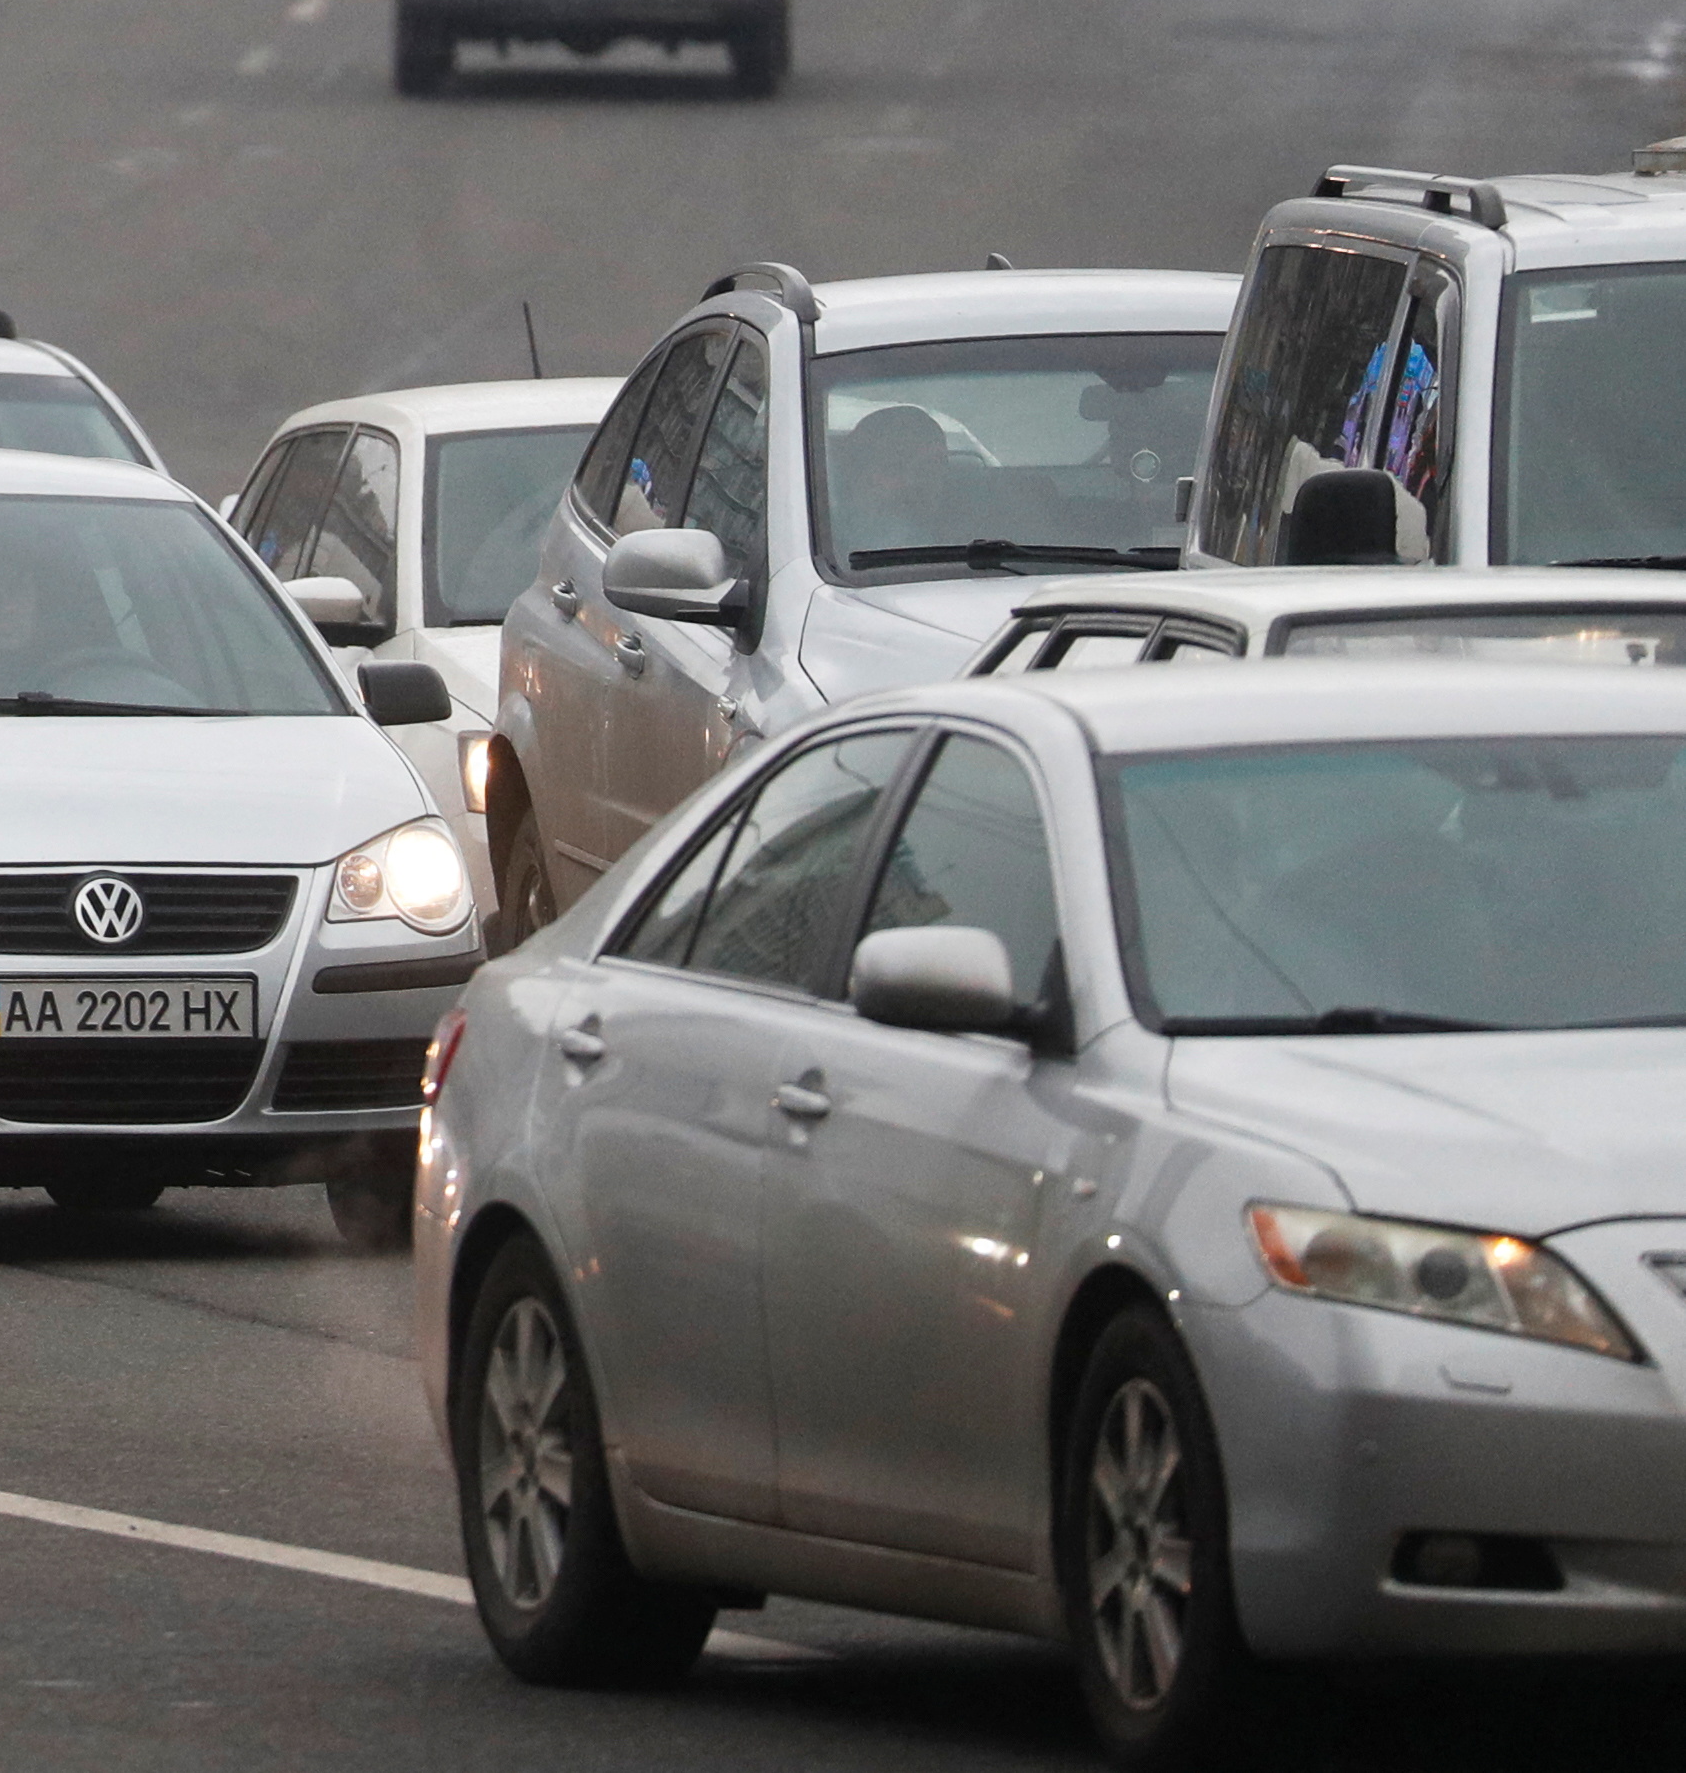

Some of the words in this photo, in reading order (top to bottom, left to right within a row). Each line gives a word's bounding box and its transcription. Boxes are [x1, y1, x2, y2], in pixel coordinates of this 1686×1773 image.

[4, 991, 63, 1032] AA
[77, 990, 171, 1032] 2202
[183, 991, 240, 1031] HX
